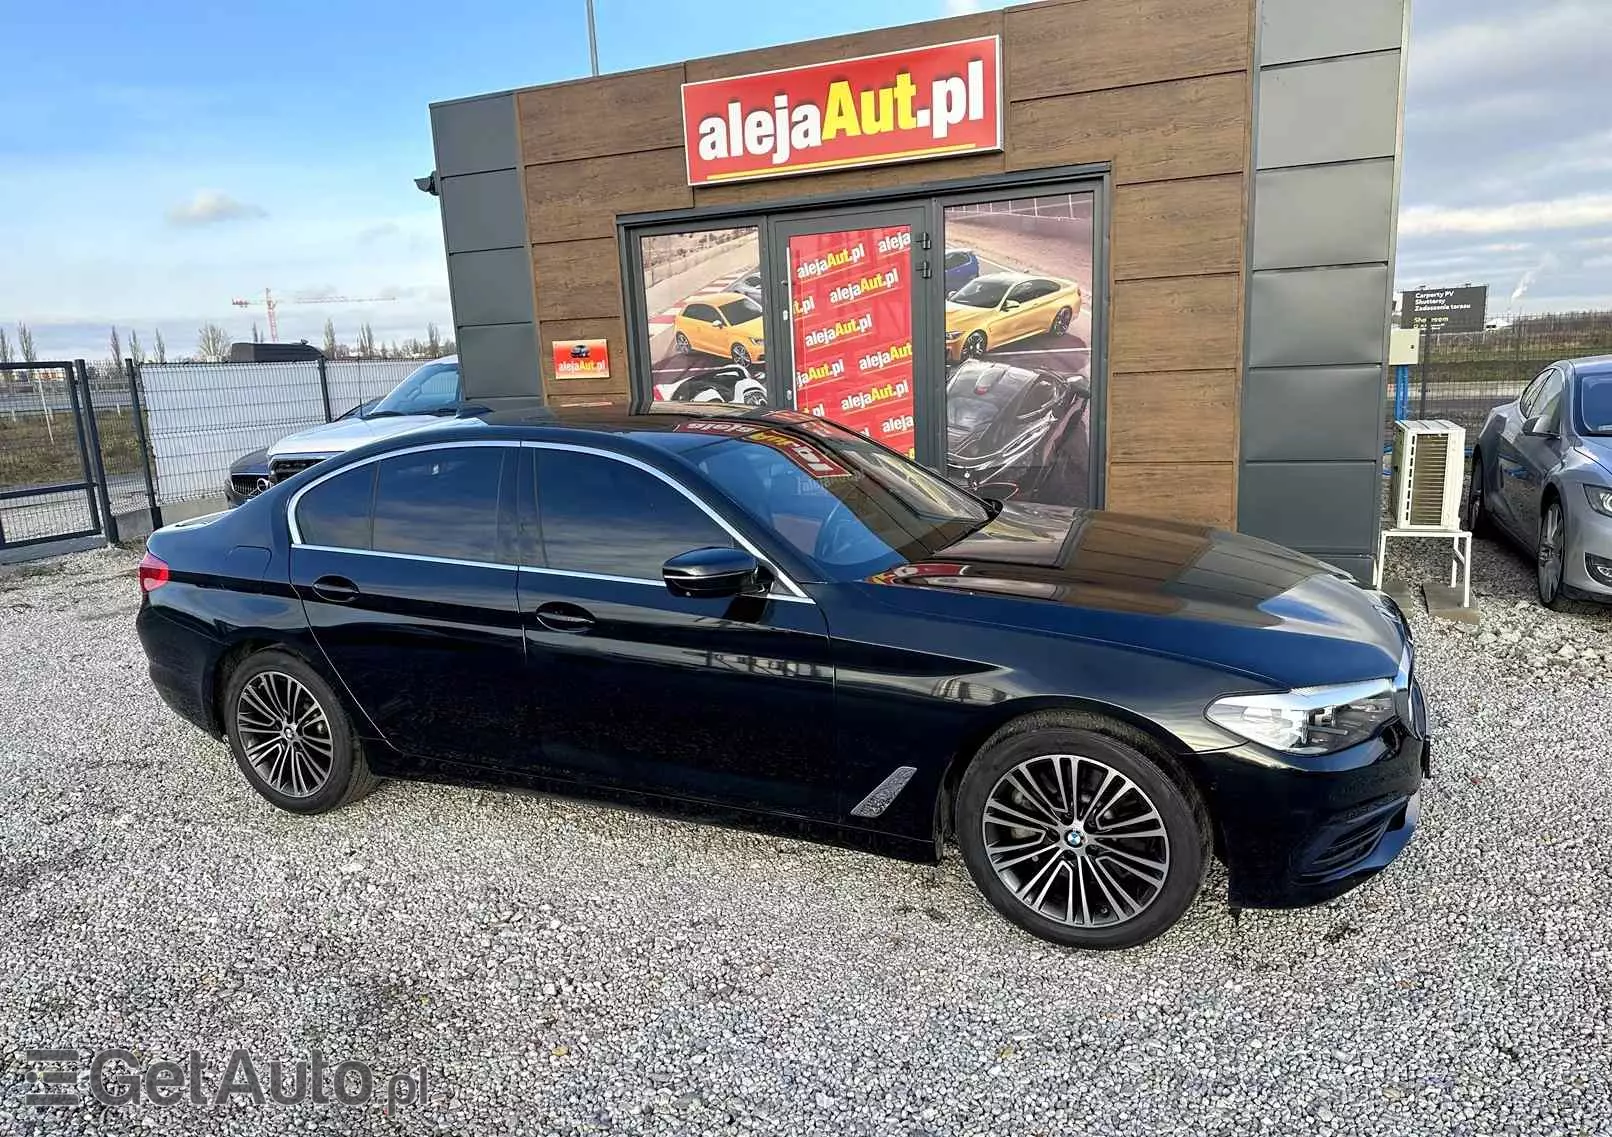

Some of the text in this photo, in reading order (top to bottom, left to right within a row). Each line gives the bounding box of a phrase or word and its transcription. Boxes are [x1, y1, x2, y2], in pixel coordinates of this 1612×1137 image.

[698, 60, 983, 164] alejaAut.pl
[797, 243, 865, 279] alejaAut.pl
[829, 268, 899, 303] alejaAut.pl
[805, 313, 872, 345] alejaAut.pl
[559, 360, 605, 375] alejaAut.pl
[797, 359, 844, 388] jaAut.pl
[841, 380, 909, 410] alejaAut.pl
